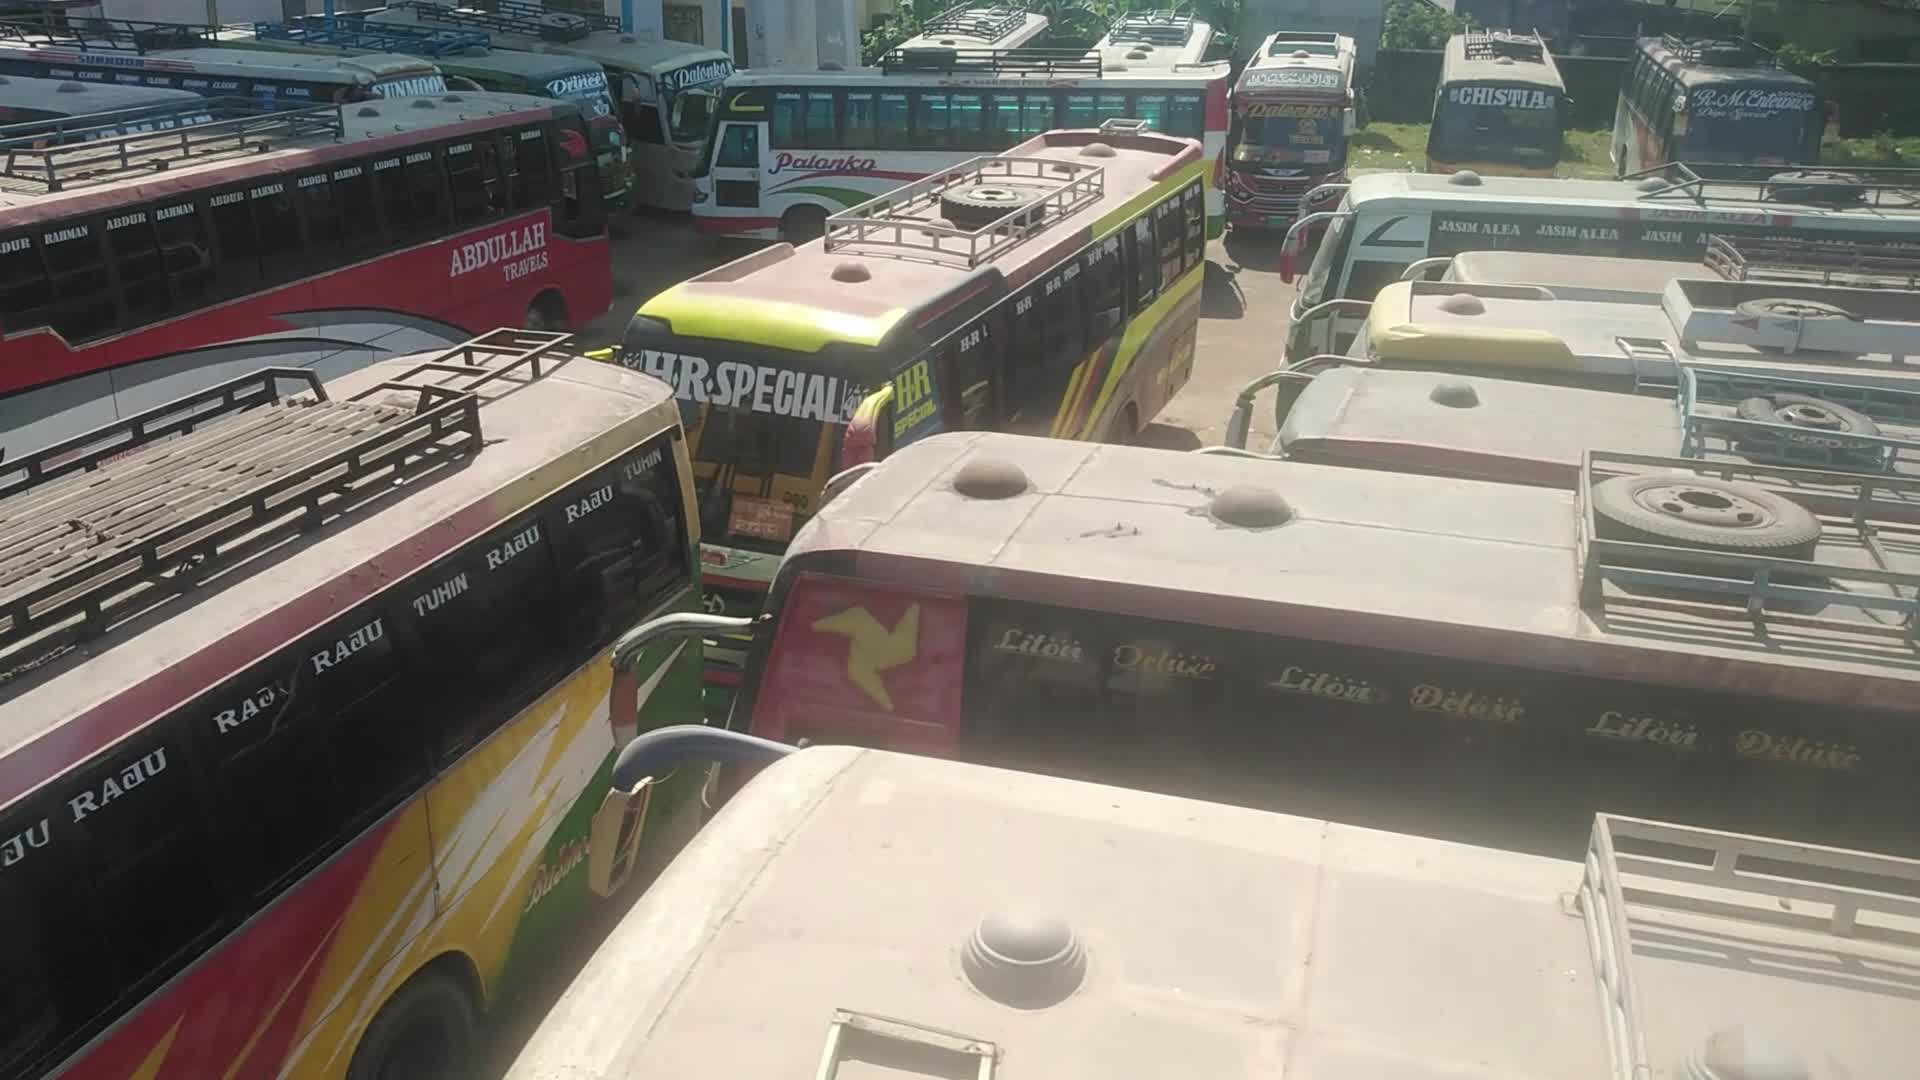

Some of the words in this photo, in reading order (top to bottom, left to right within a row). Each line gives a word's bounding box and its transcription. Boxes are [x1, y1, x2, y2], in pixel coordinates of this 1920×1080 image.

[1460, 87, 1546, 109] CHISTIA
[44, 225, 88, 245] RAHMAN
[106, 212, 146, 230] ABDUR
[156, 203, 194, 221] RAHMAN
[210, 191, 244, 207] ABDUR
[251, 183, 284, 200] RAHMAN
[297, 174, 328, 188] ABDUR
[334, 167, 362, 181] RAHMAN
[374, 158, 400, 171] ABDUR
[406, 152, 432, 165] RAHMAN
[450, 222, 545, 277] ABDULLAH
[1438, 220, 1478, 233] JASIM
[1536, 224, 1577, 237] JASIM
[1641, 231, 1682, 242] JASIM
[503, 251, 548, 282] TRAVELS
[0, 818, 49, 867] JU
[212, 684, 287, 734] RAJ
[413, 572, 469, 616] TUHIN
[623, 448, 662, 480] TUHIN
